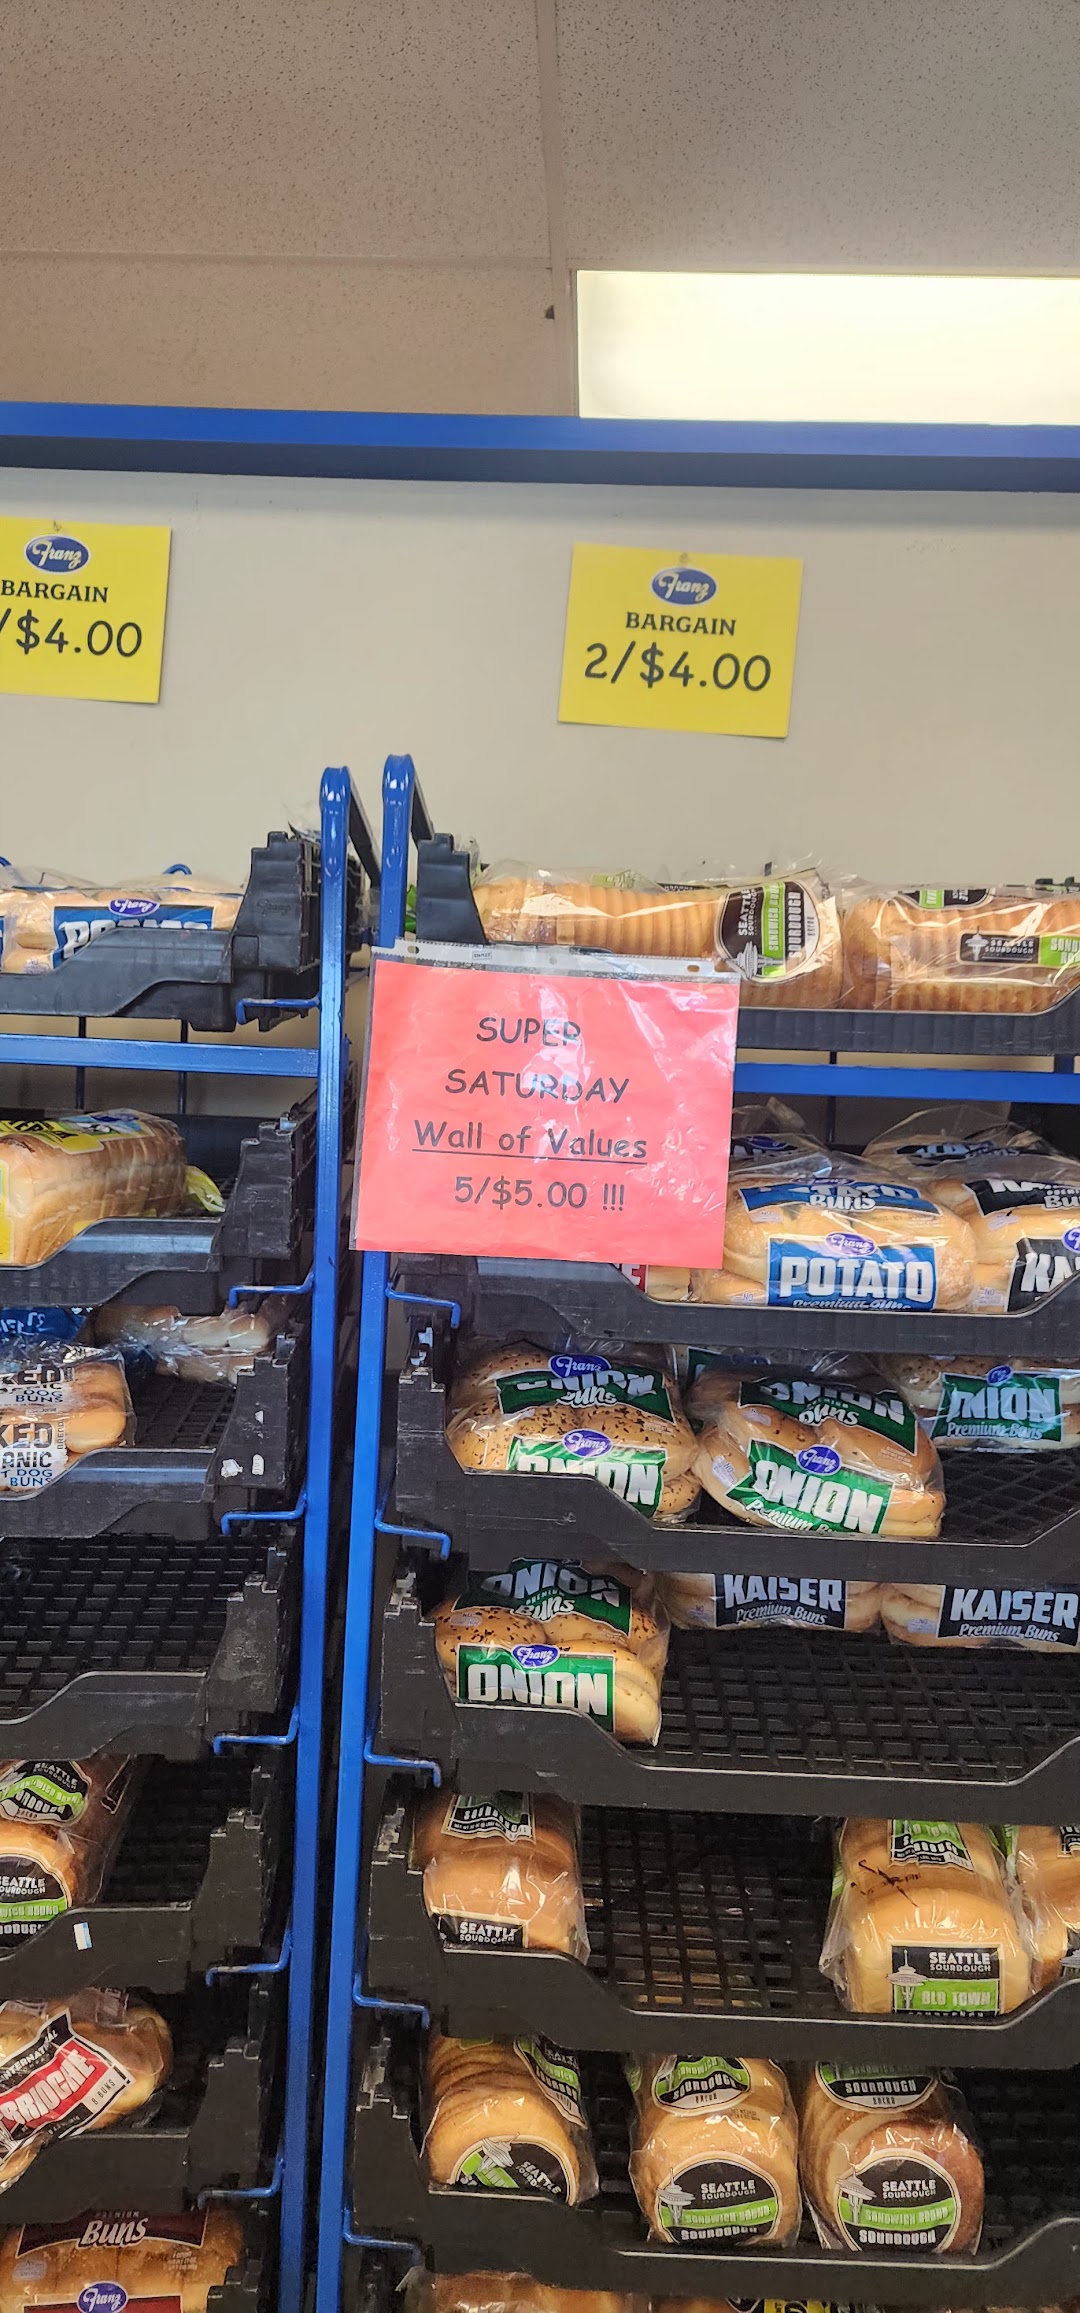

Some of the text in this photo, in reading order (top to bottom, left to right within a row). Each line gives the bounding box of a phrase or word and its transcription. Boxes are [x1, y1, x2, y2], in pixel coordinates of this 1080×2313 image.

[31, 540, 83, 570] Franz
[1, 579, 109, 603] BARGAIN
[658, 572, 710, 602] Franz
[625, 611, 737, 636] BARGAIN
[584, 641, 771, 692] 2/$4.00
[476, 1016, 581, 1047] SUPER
[445, 1068, 630, 1104] SATURDAY
[414, 1119, 648, 1160] Wall of Values
[454, 1176, 625, 1212] 5/$5.00 !!!
[779, 1256, 934, 1303] POTATO
[947, 1421, 1043, 1440] Premium Buns
[16, 1469, 53, 1478] DOG
[752, 1459, 884, 1534] ONION
[722, 1574, 842, 1613] KAISER
[736, 1602, 828, 1625] Premium Buns
[949, 1588, 1078, 1629] KAISER
[958, 1622, 1061, 1643] Premium Buns
[467, 1663, 608, 1716] ONION
[929, 1951, 991, 1966] SEATTLE
[930, 1964, 992, 1972] SOURDOUGH
[921, 1990, 991, 2007] OLD TOWN
[845, 2080, 917, 2094] SOURDOUGH
[701, 2179, 756, 2194] SEATTLE
[701, 2189, 756, 2200] SOURDOUGH
[882, 2179, 937, 2192] SEATTLE
[882, 2189, 937, 2200] SOURDOUGH
[80, 2217, 148, 2246] Buns
[859, 2229, 936, 2245] SOURDOUGH
[83, 2289, 122, 2312] Franz
